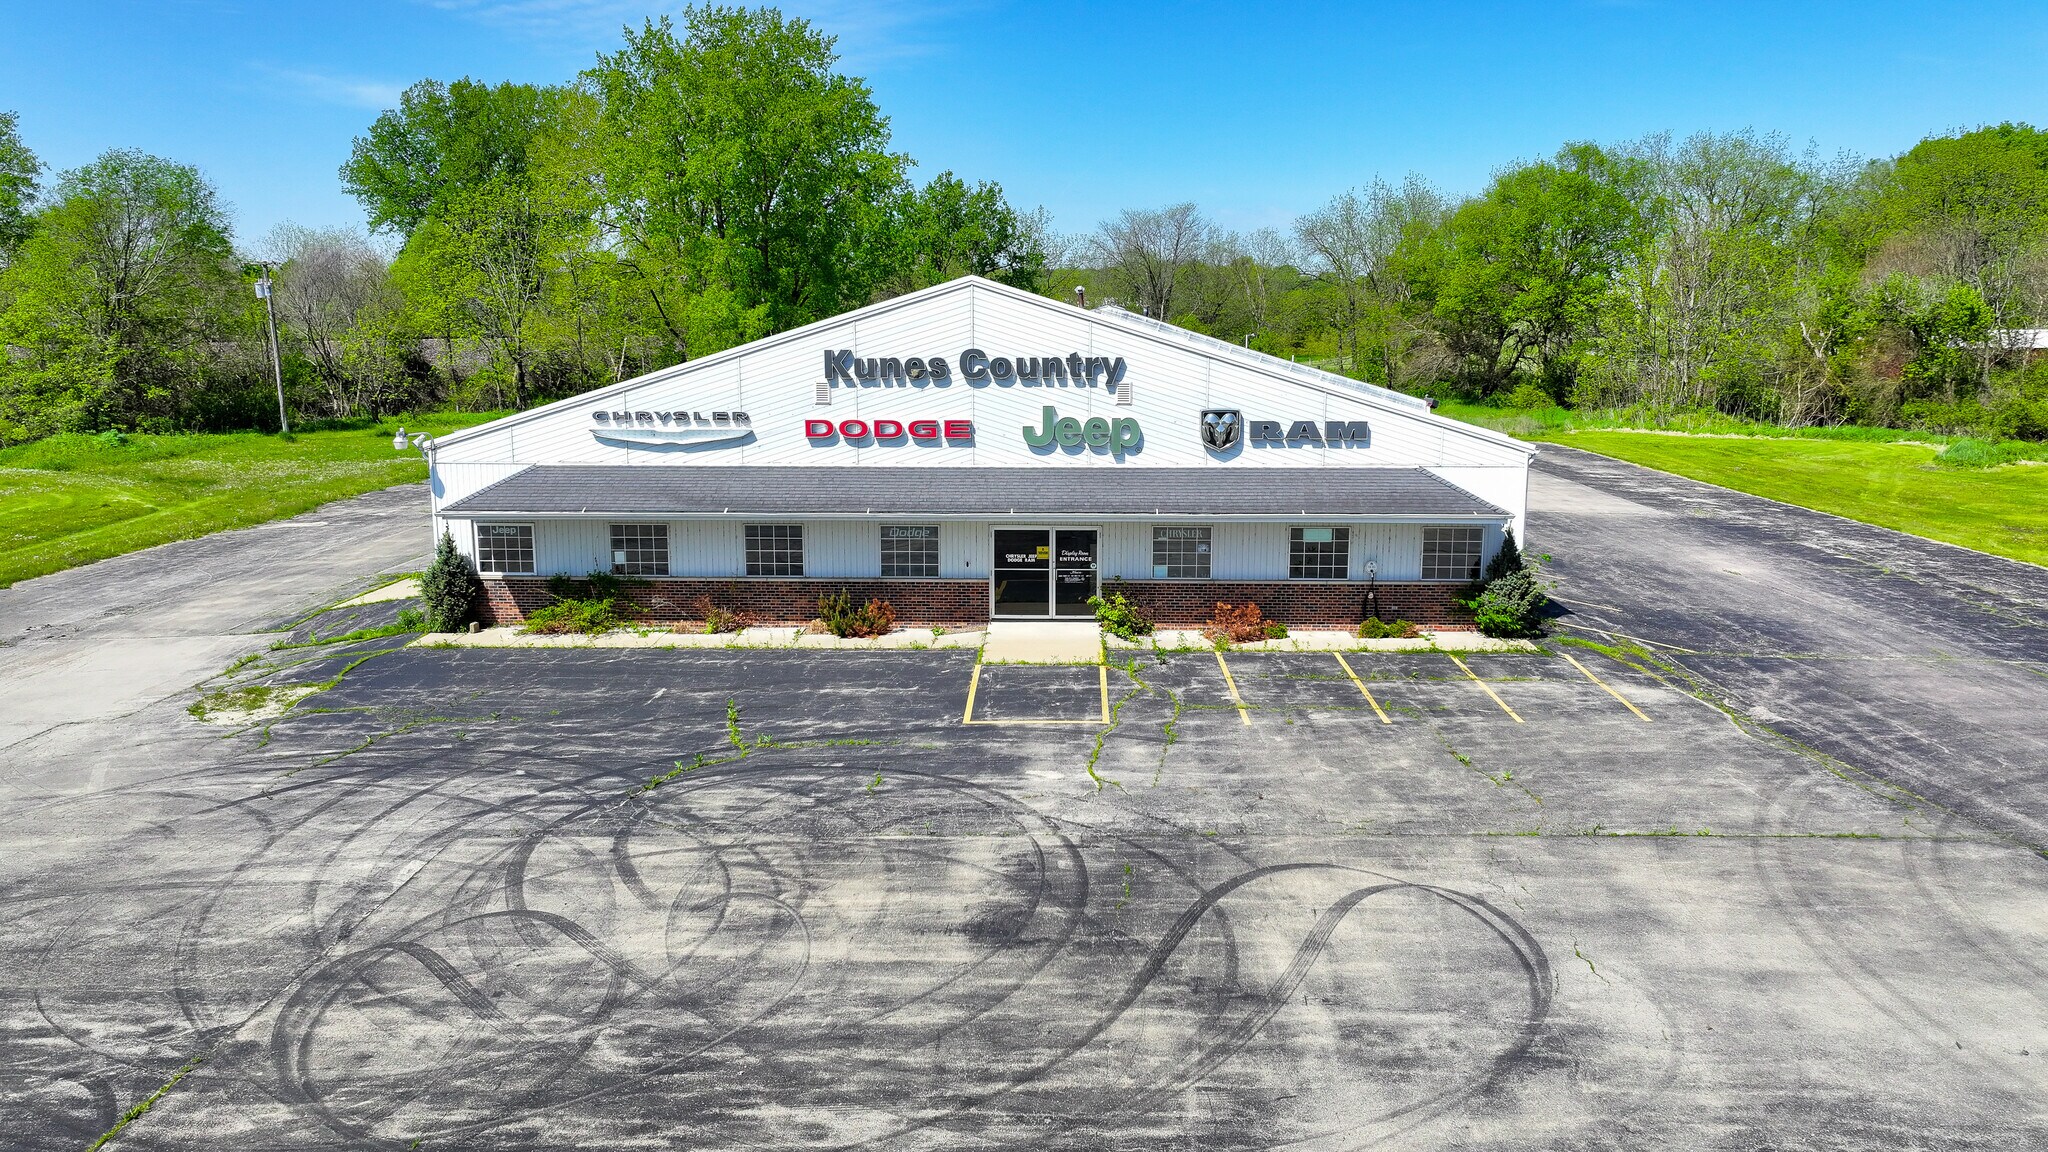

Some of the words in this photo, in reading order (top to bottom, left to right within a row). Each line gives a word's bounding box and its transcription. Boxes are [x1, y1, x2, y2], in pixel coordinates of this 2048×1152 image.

[823, 349, 947, 381] Kunes
[959, 348, 1124, 385] Country
[591, 410, 751, 423] CHRYSLER
[804, 419, 972, 440] DODGE
[1022, 405, 1141, 455] Jeep
[1249, 420, 1369, 441] RAM
[492, 526, 517, 535] Jeep
[889, 527, 930, 538] Dodge
[1160, 529, 1203, 538] CHRYSLER
